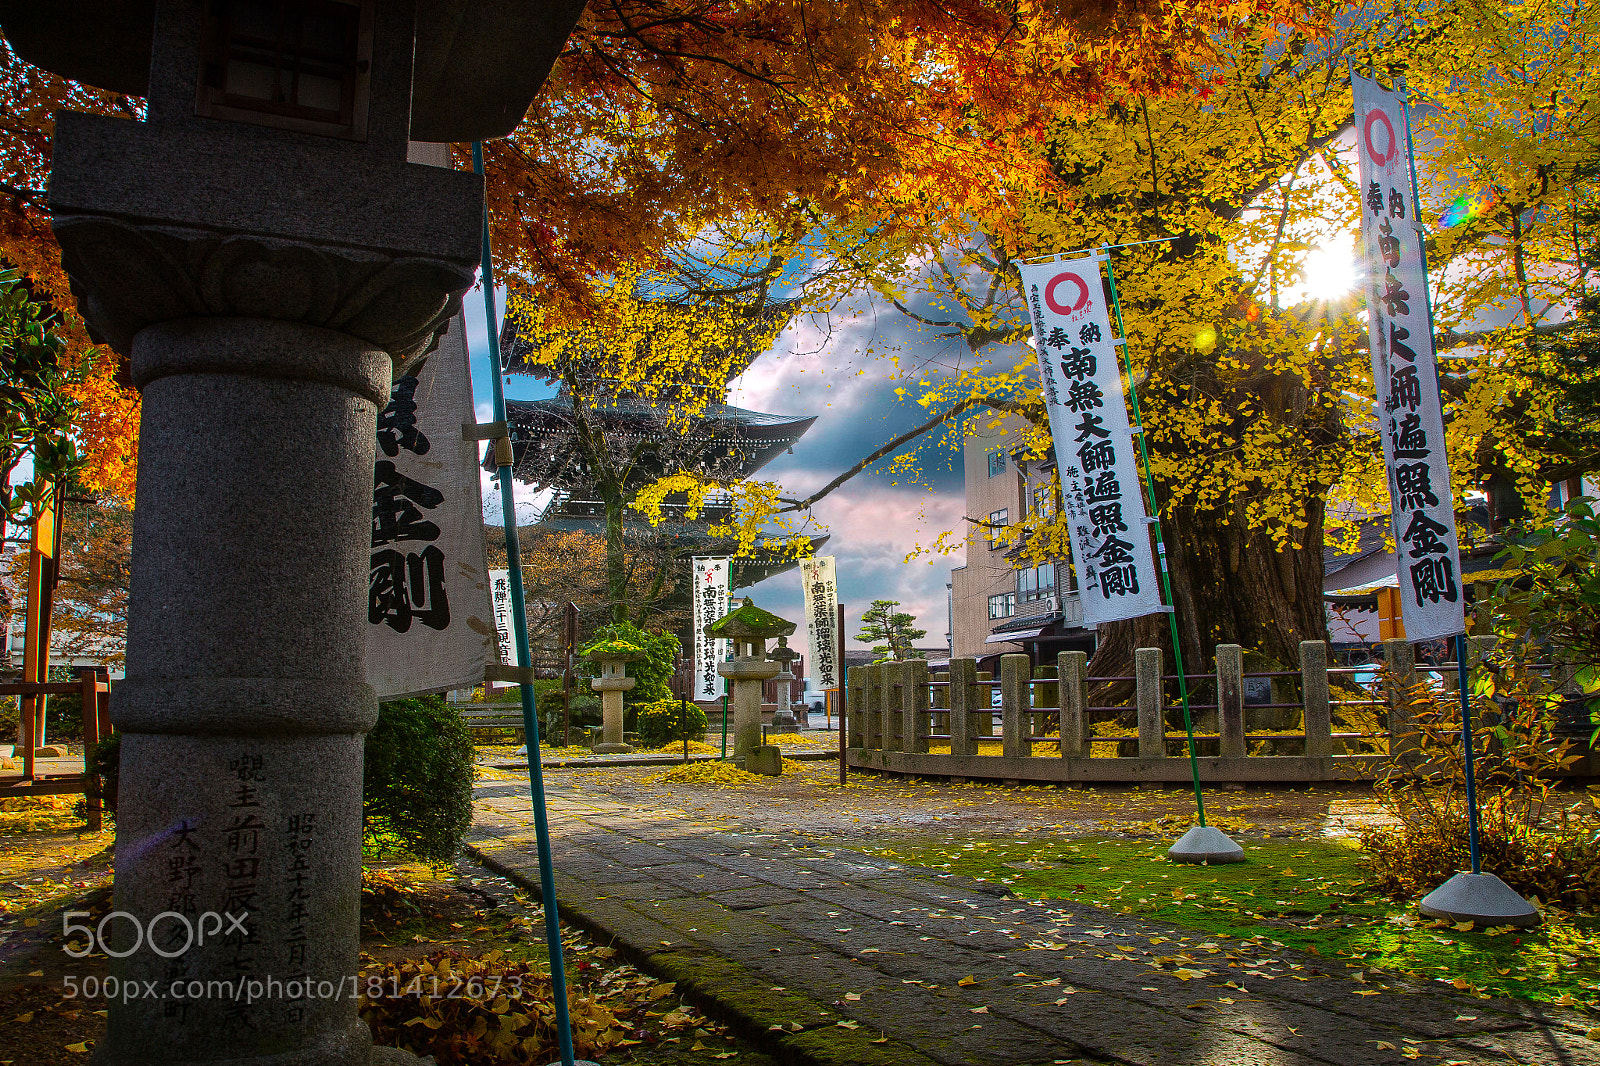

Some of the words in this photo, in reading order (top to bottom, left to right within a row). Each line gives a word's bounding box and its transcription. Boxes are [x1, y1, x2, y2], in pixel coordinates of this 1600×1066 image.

[1060, 346, 1140, 600] 南無大師遍照金剛
[701, 584, 717, 696] 南無薬瑠璃光如来
